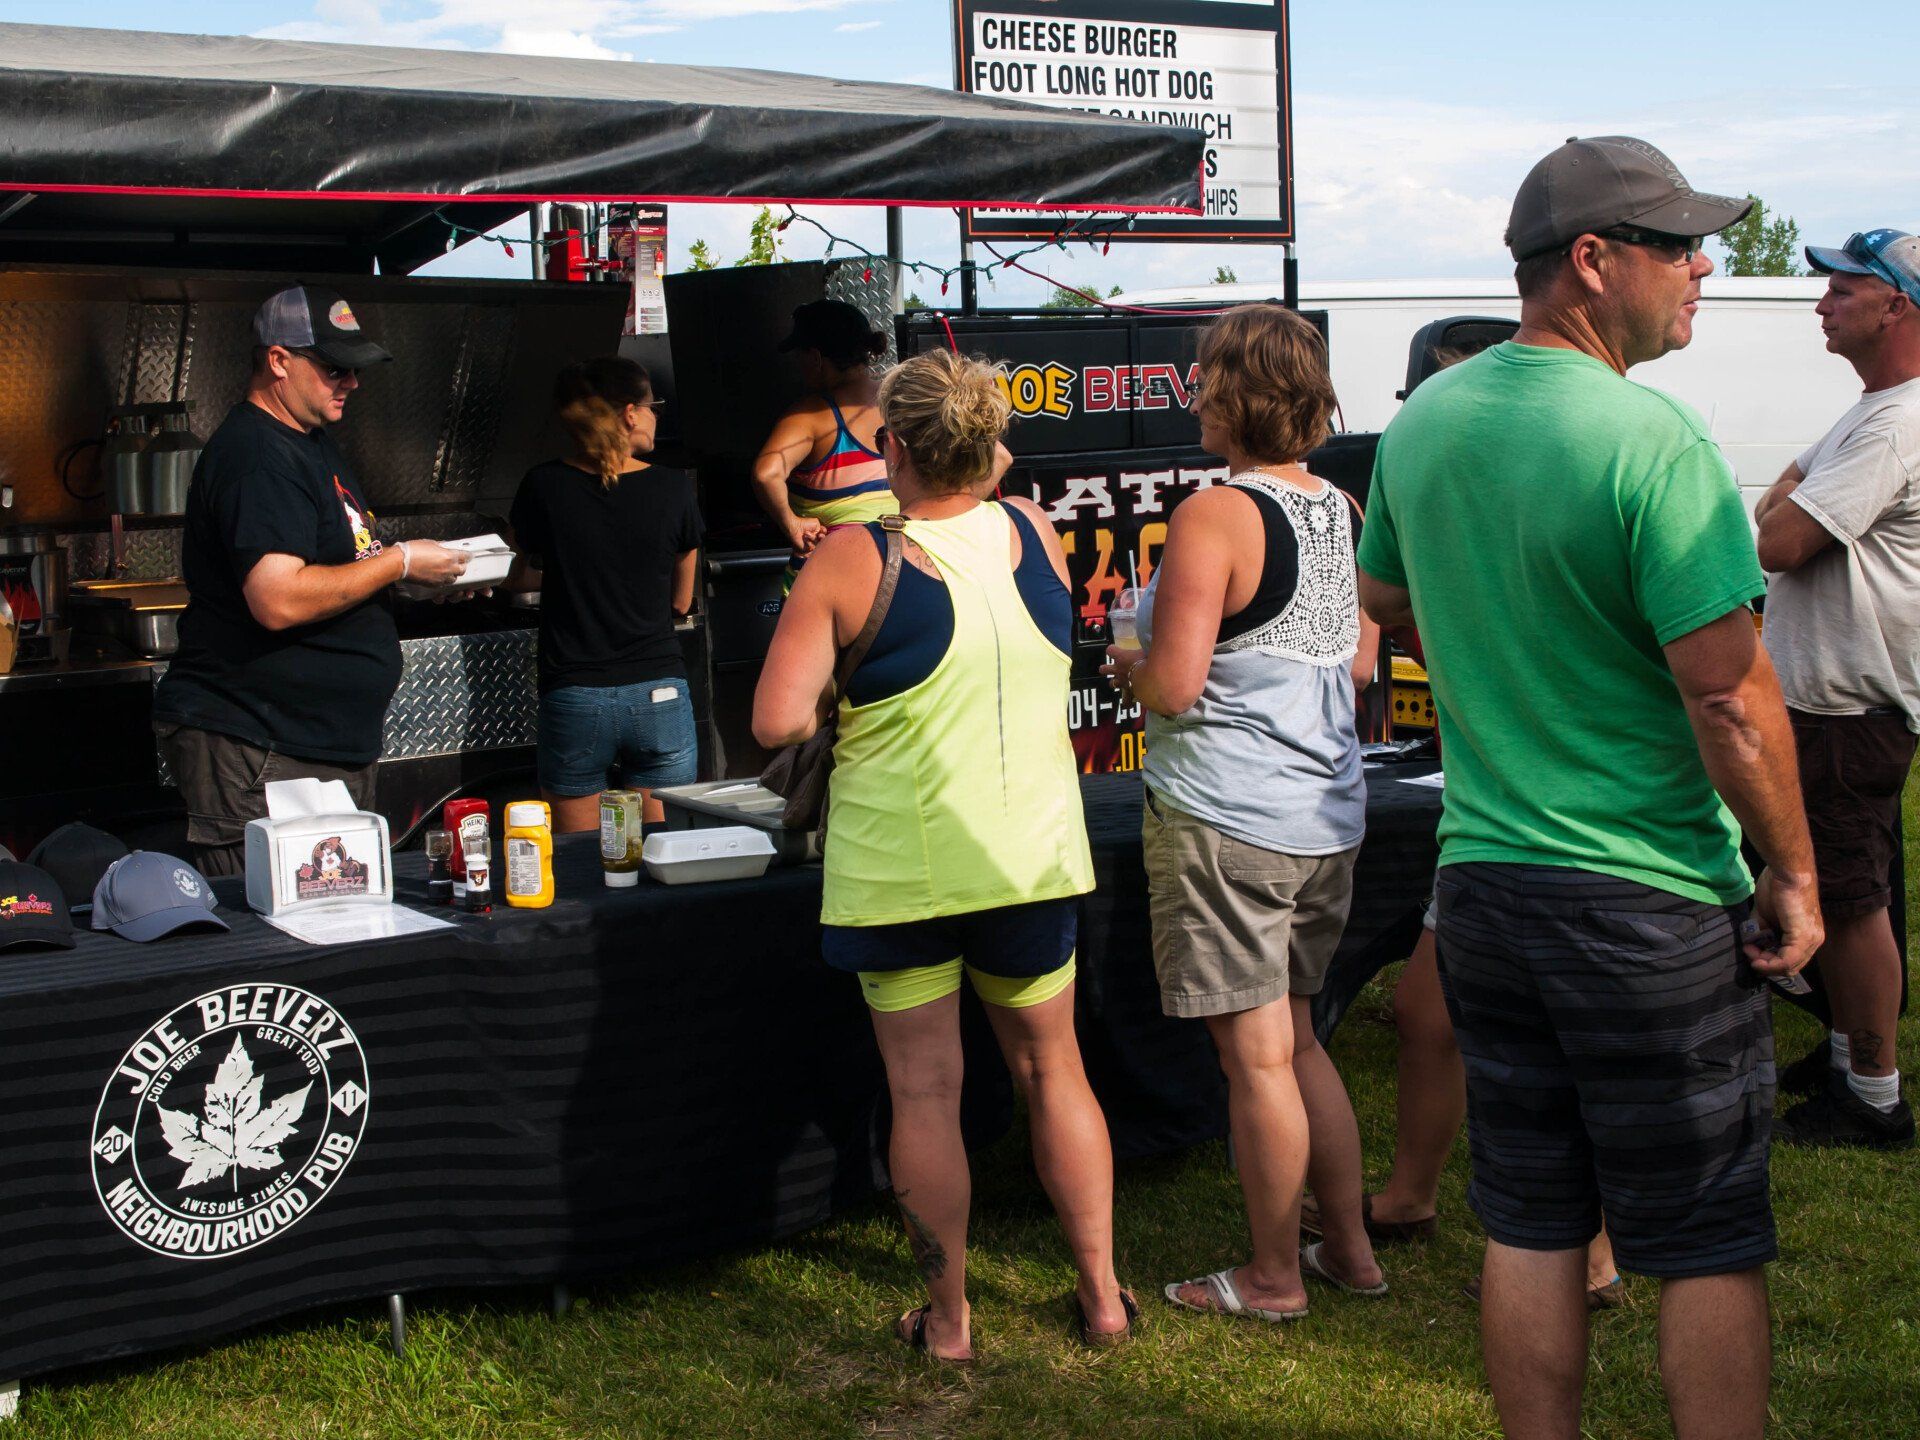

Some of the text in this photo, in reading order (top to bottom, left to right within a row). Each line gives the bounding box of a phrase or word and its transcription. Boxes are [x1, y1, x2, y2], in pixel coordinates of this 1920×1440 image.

[982, 18, 1178, 59] CHEESE BURGER
[974, 61, 1213, 100] FOOT LONG HOT DOG
[1204, 188, 1239, 217] HIPS
[466, 818, 484, 828] HEINZ
[118, 987, 354, 1095] JOE BEEVERZ
[256, 1026, 321, 1076] GREAT FOOD
[147, 1044, 202, 1103] COLD BEER
[340, 1089, 358, 1108] 11
[100, 1133, 125, 1156] 20
[304, 1132, 354, 1190] PUB
[180, 1171, 292, 1214] AWESOME TIMES
